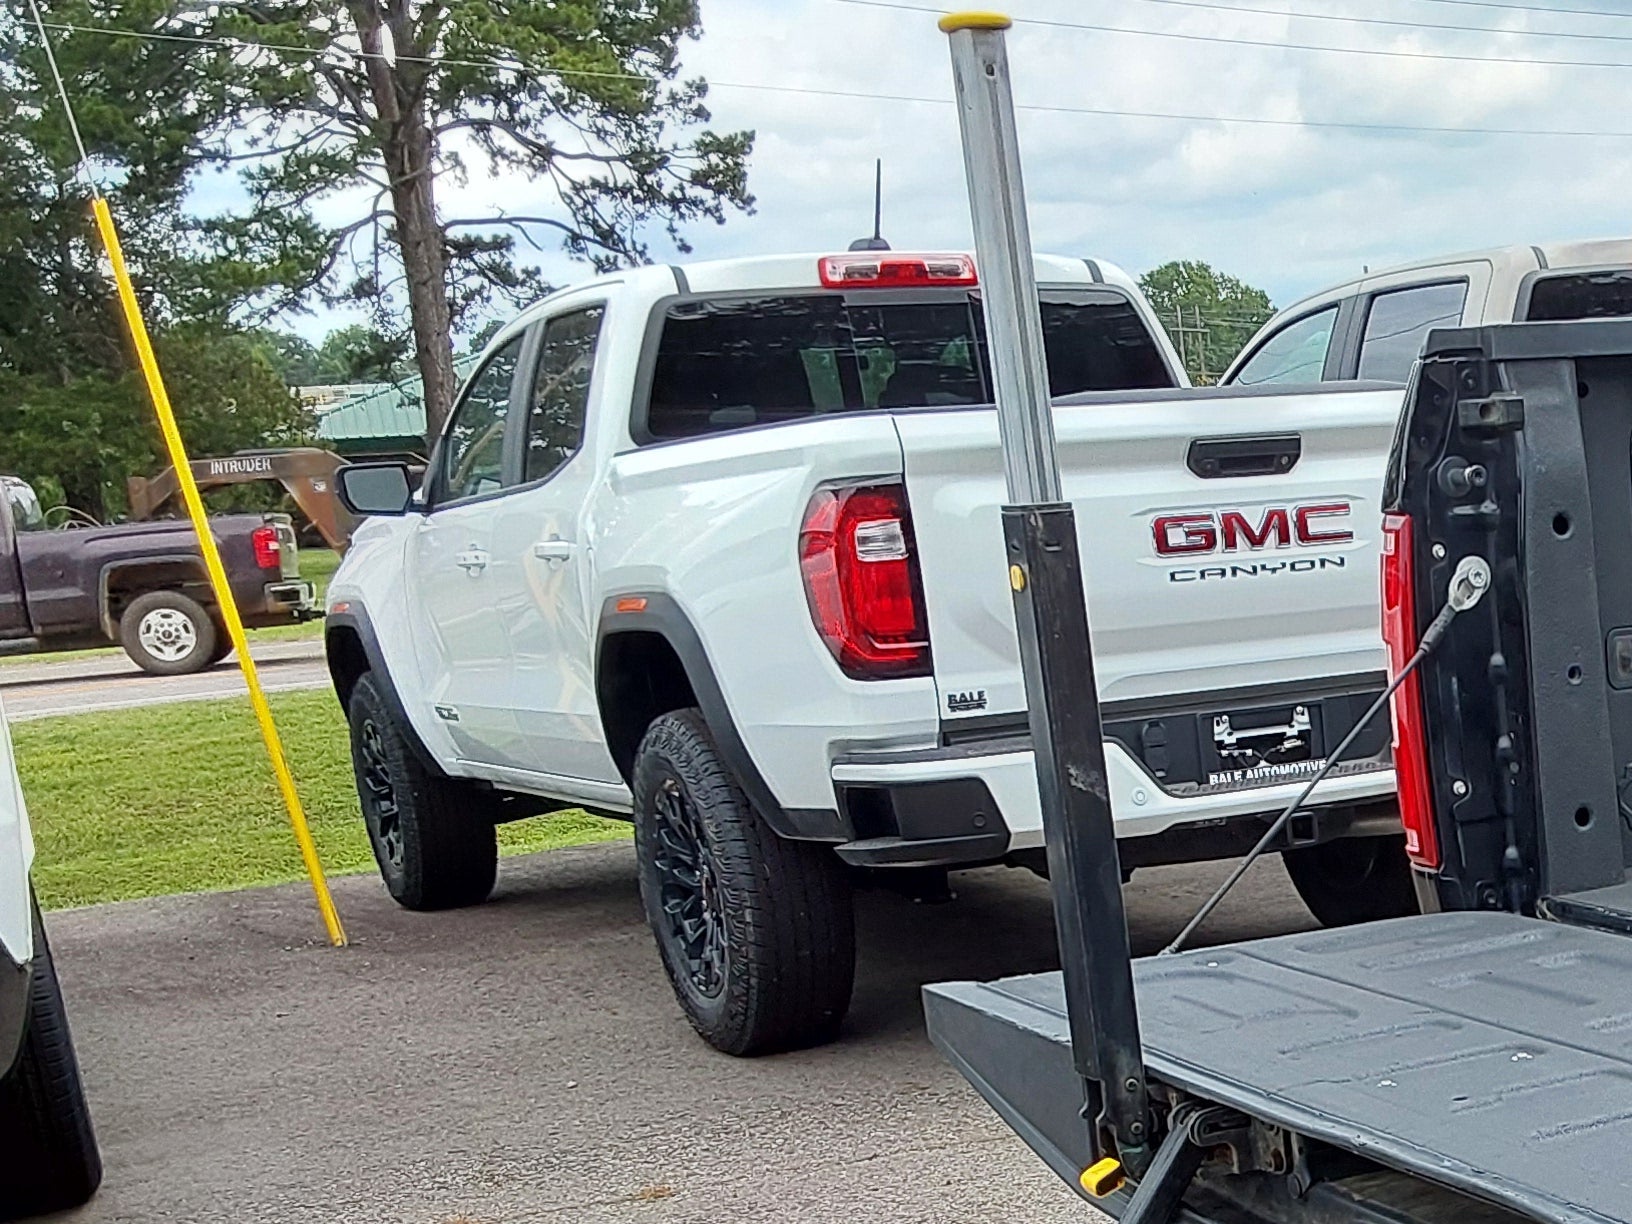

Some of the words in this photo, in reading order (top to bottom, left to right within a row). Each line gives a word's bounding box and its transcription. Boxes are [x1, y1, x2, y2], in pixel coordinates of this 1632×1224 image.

[210, 457, 272, 475] INTRUDER
[1151, 500, 1354, 558] GMC
[1169, 556, 1346, 583] CANYON
